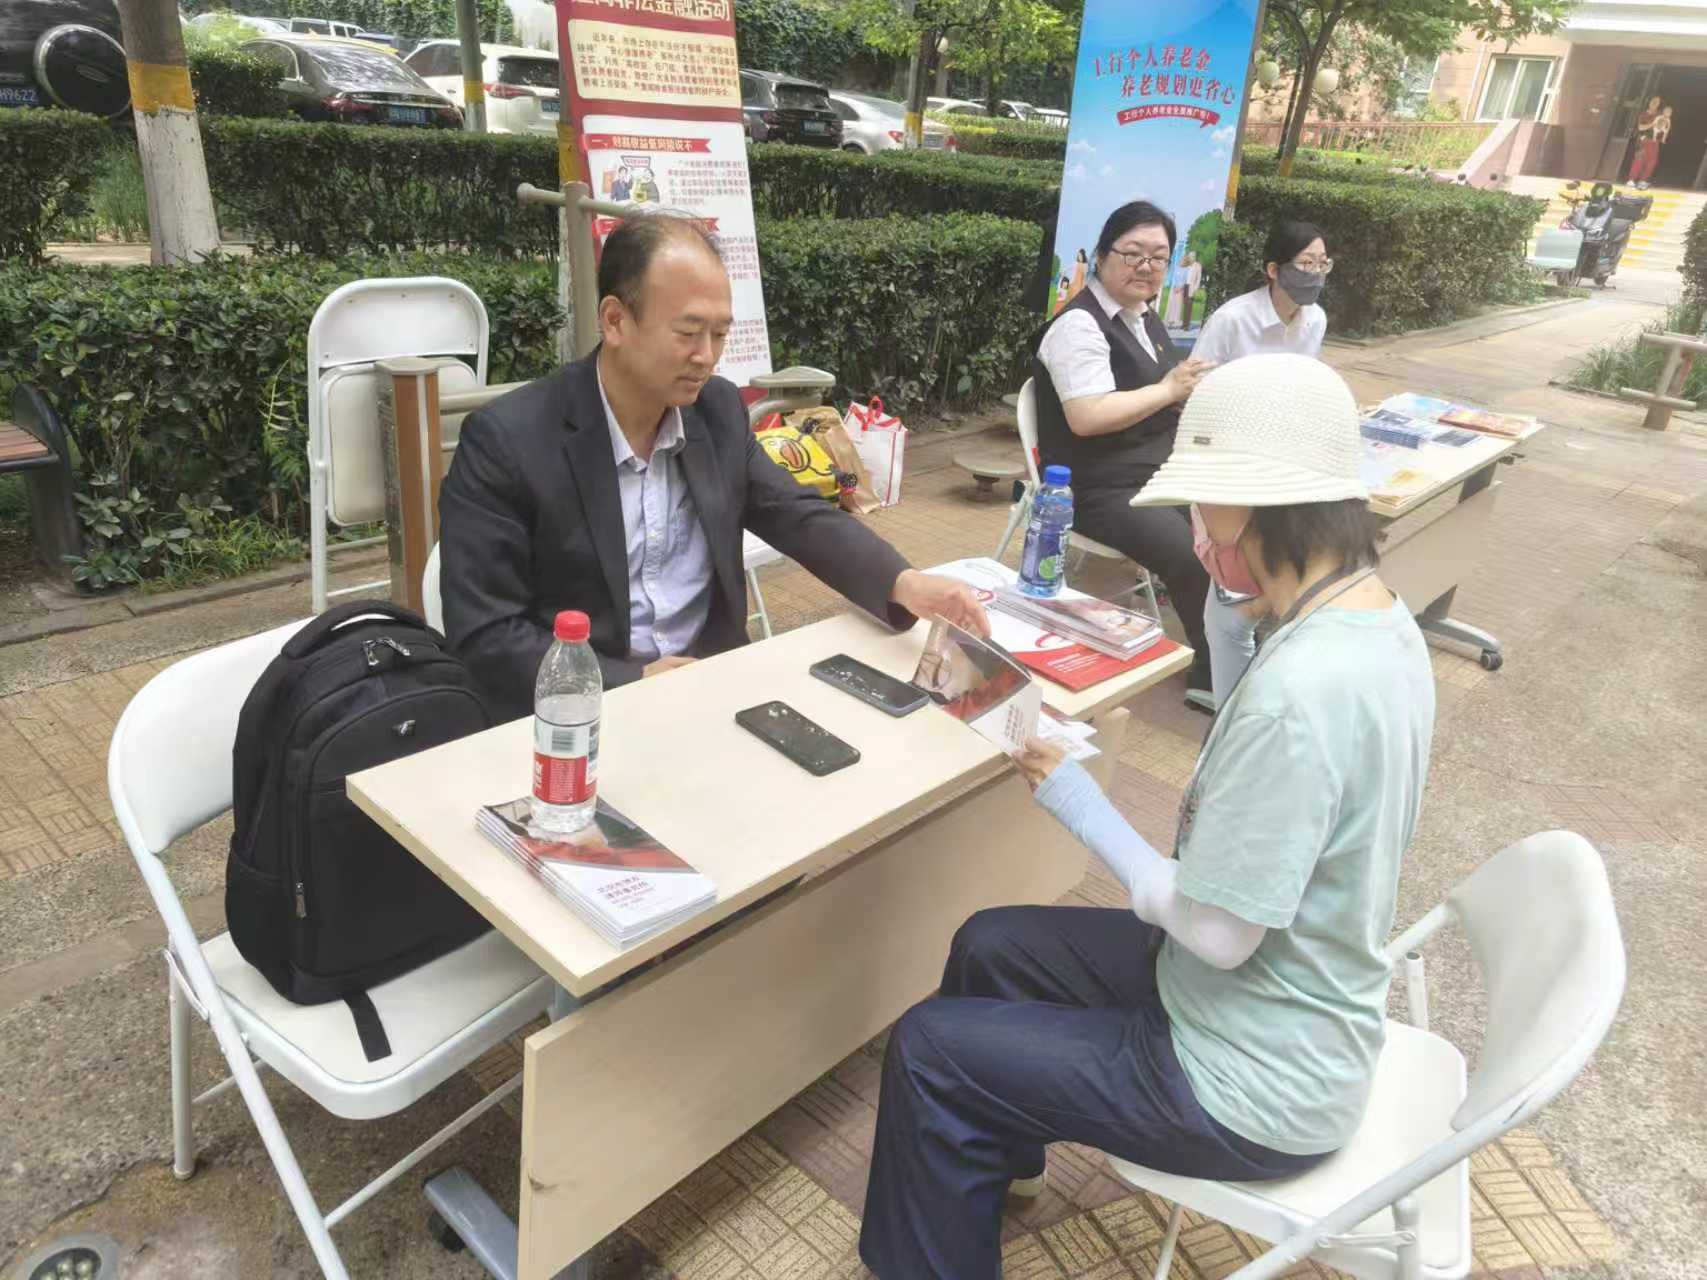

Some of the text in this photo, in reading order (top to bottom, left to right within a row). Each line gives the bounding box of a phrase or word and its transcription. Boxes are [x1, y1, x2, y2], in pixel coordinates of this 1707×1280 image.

[573, 0, 731, 21] 法金融活动
[1092, 46, 1211, 77] 工行个人养老金
[1121, 74, 1236, 105] 养老规划更省心
